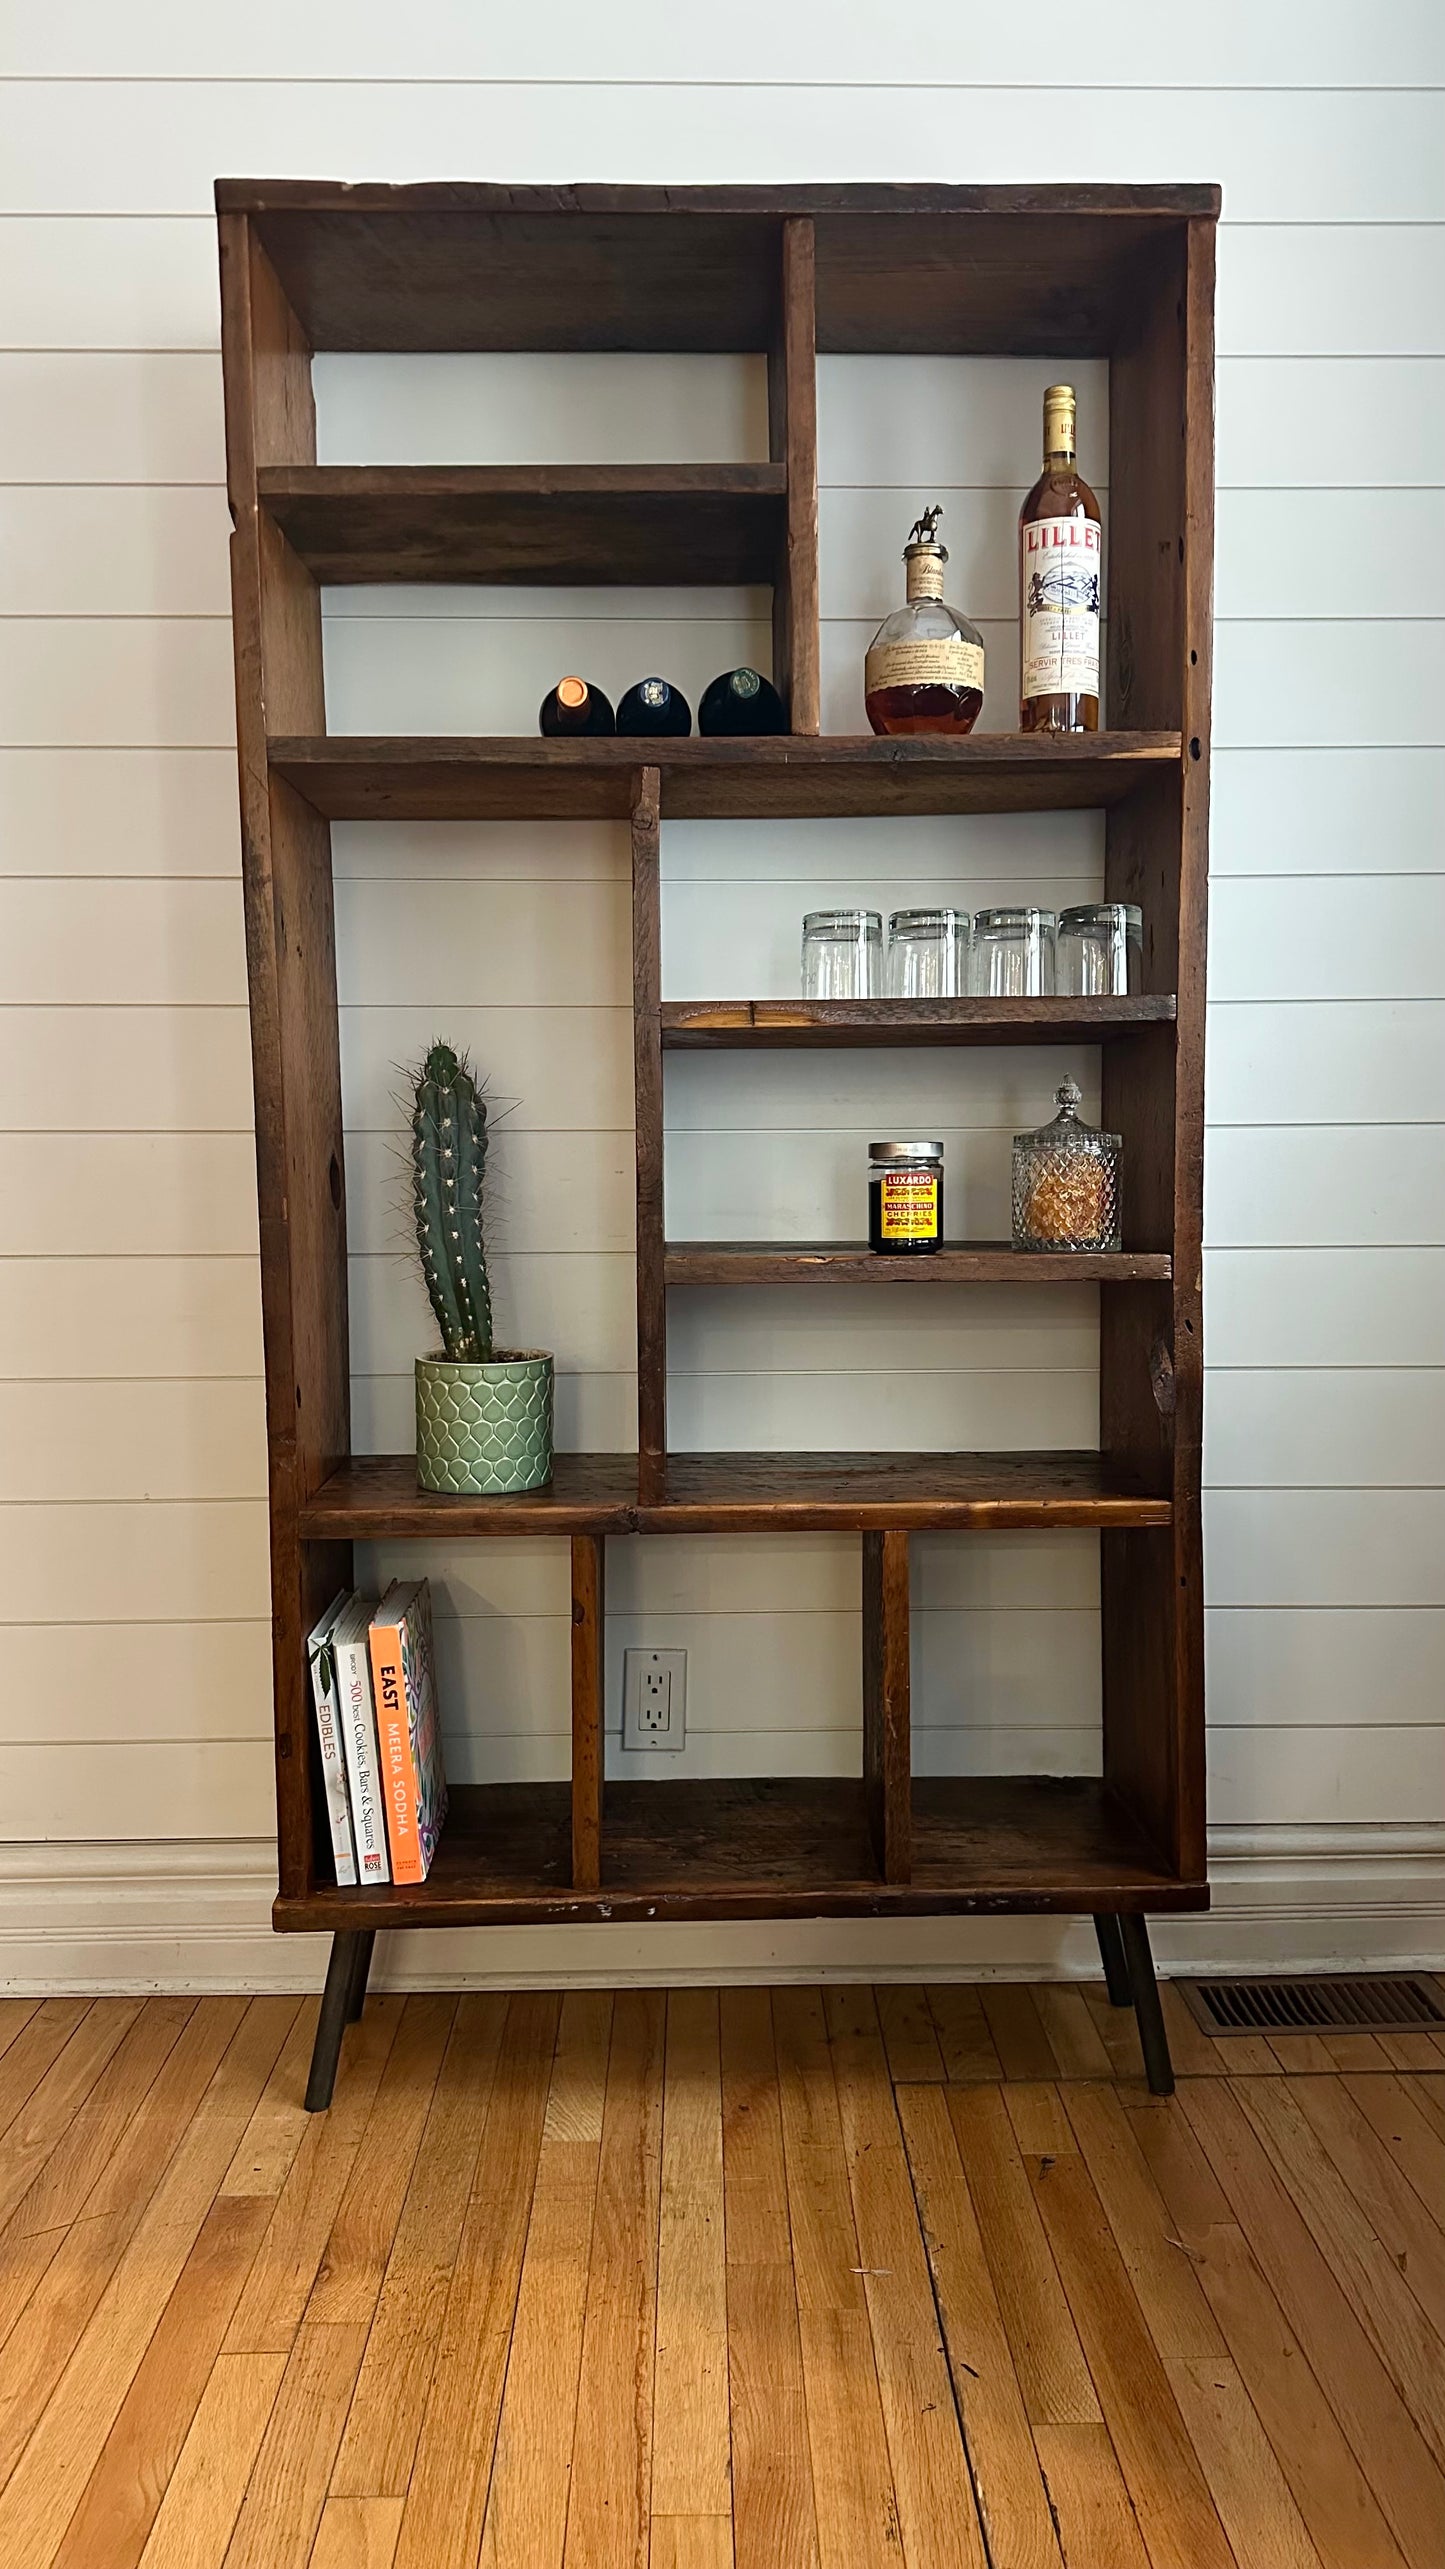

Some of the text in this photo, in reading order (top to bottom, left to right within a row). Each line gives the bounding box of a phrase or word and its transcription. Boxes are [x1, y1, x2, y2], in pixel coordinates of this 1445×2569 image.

[1027, 525, 1101, 553] LILLET
[1052, 631, 1085, 640] LILLET
[1029, 657, 1058, 669] SERVIR
[888, 1175, 932, 1185] LUXARDO
[350, 1680, 363, 1702] 500
[352, 1704, 361, 1722] best
[319, 1704, 336, 1760] EDIBLES
[354, 1723, 368, 1768] Cookies,
[380, 1665, 409, 1836] EAST MEERA SODHA
[359, 1769, 370, 1794] Bars
[361, 1796, 373, 1806] &
[361, 1807, 375, 1850] Squares
[364, 1860, 382, 1870] ROSE
